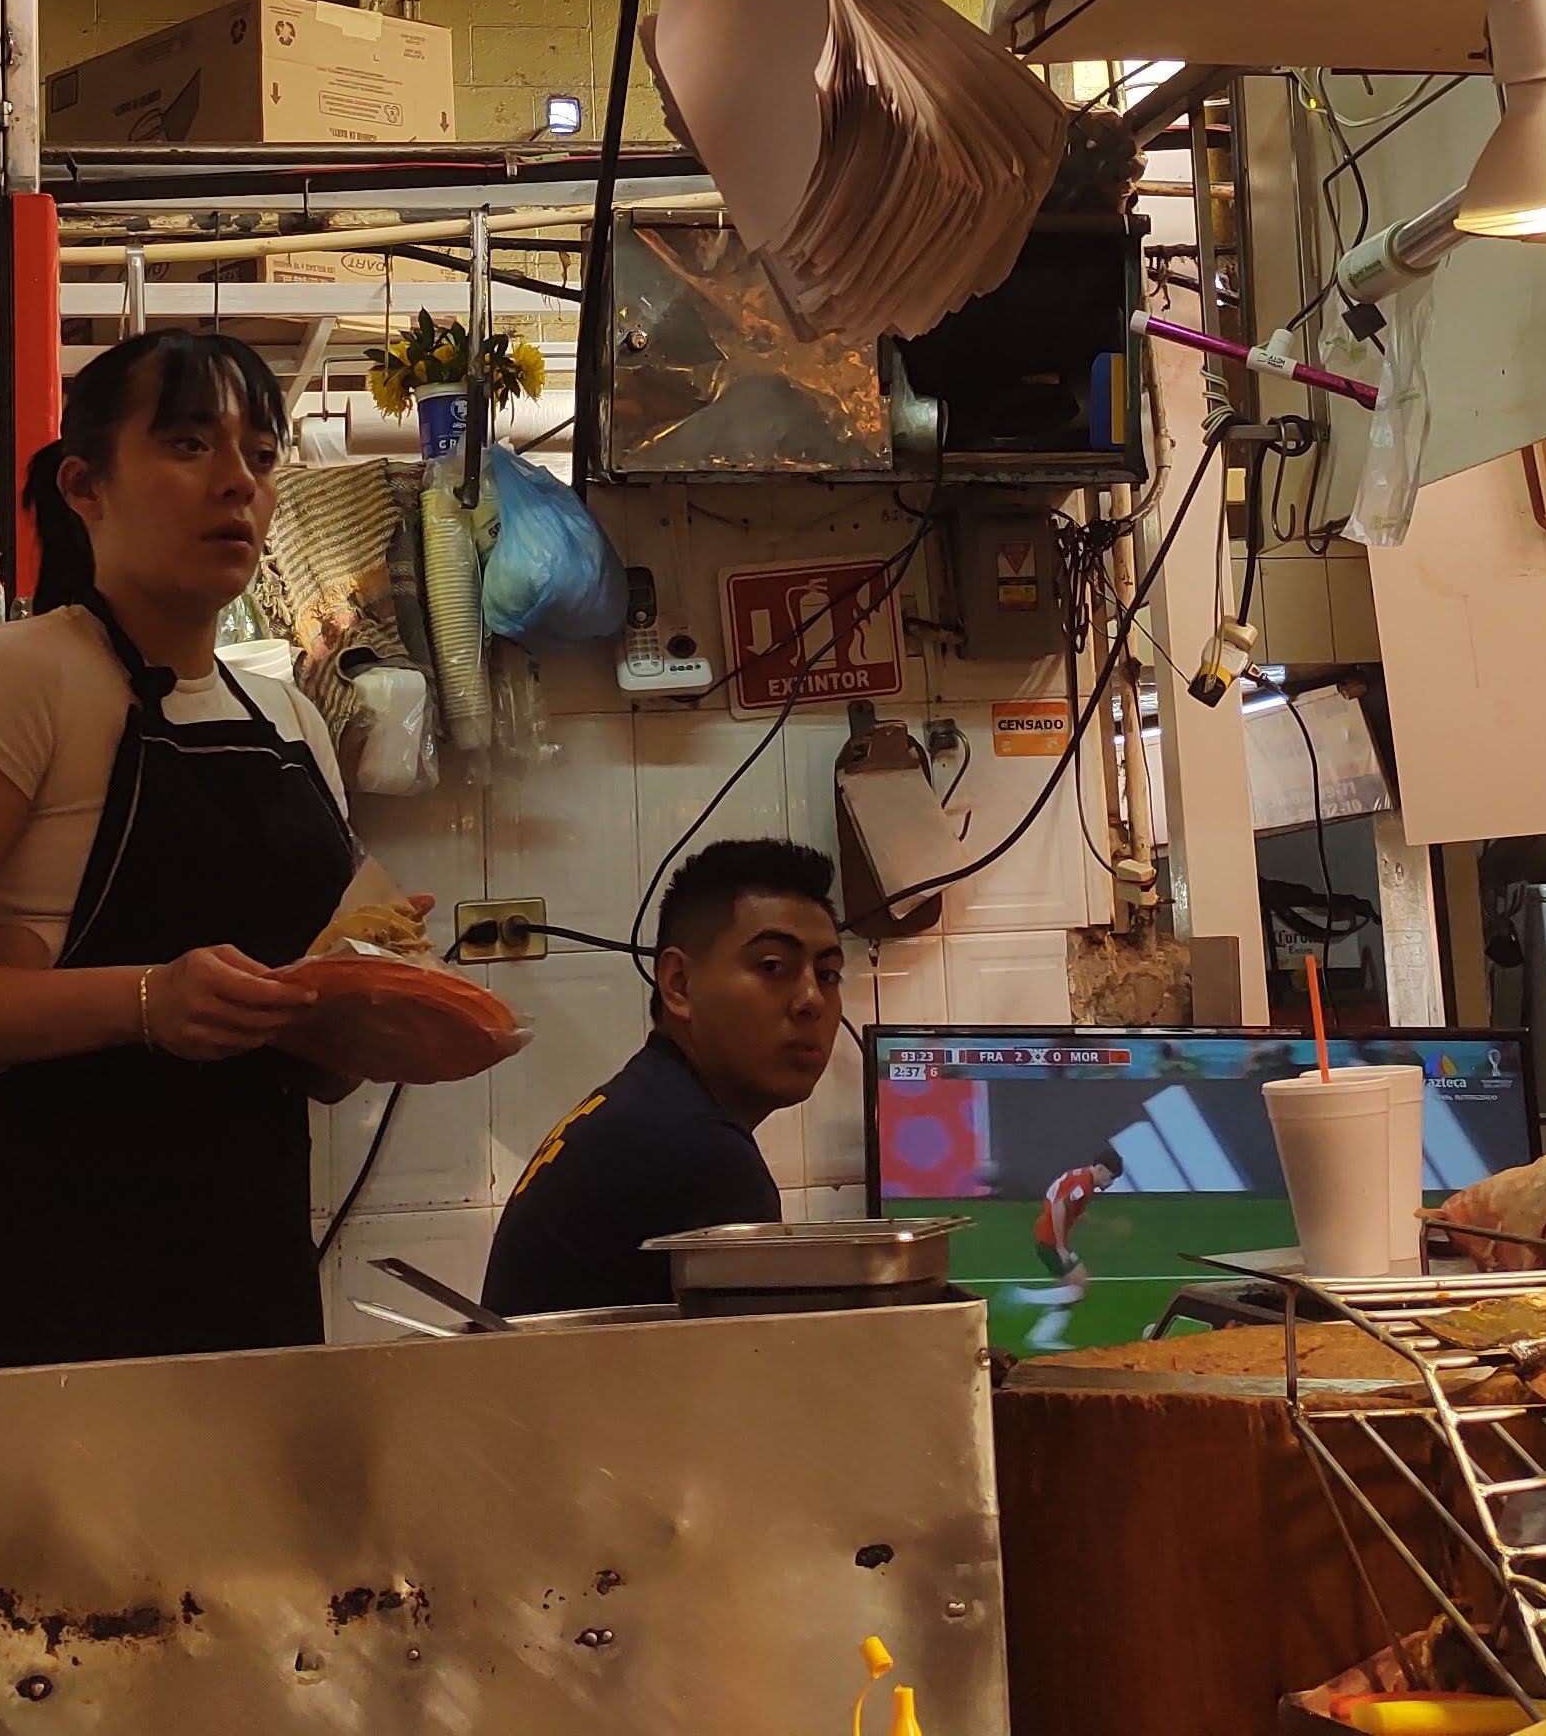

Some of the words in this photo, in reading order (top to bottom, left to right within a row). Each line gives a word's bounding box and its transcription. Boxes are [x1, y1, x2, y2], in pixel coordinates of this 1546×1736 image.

[768, 669, 870, 697] EXTINTOR
[997, 719, 1064, 732] CENSADO
[979, 1051, 1004, 1062] FRA
[1015, 1051, 1023, 1062] 2
[1053, 1051, 1061, 1062] 0
[1070, 1051, 1099, 1062] MOR
[930, 1067, 938, 1077] 6
